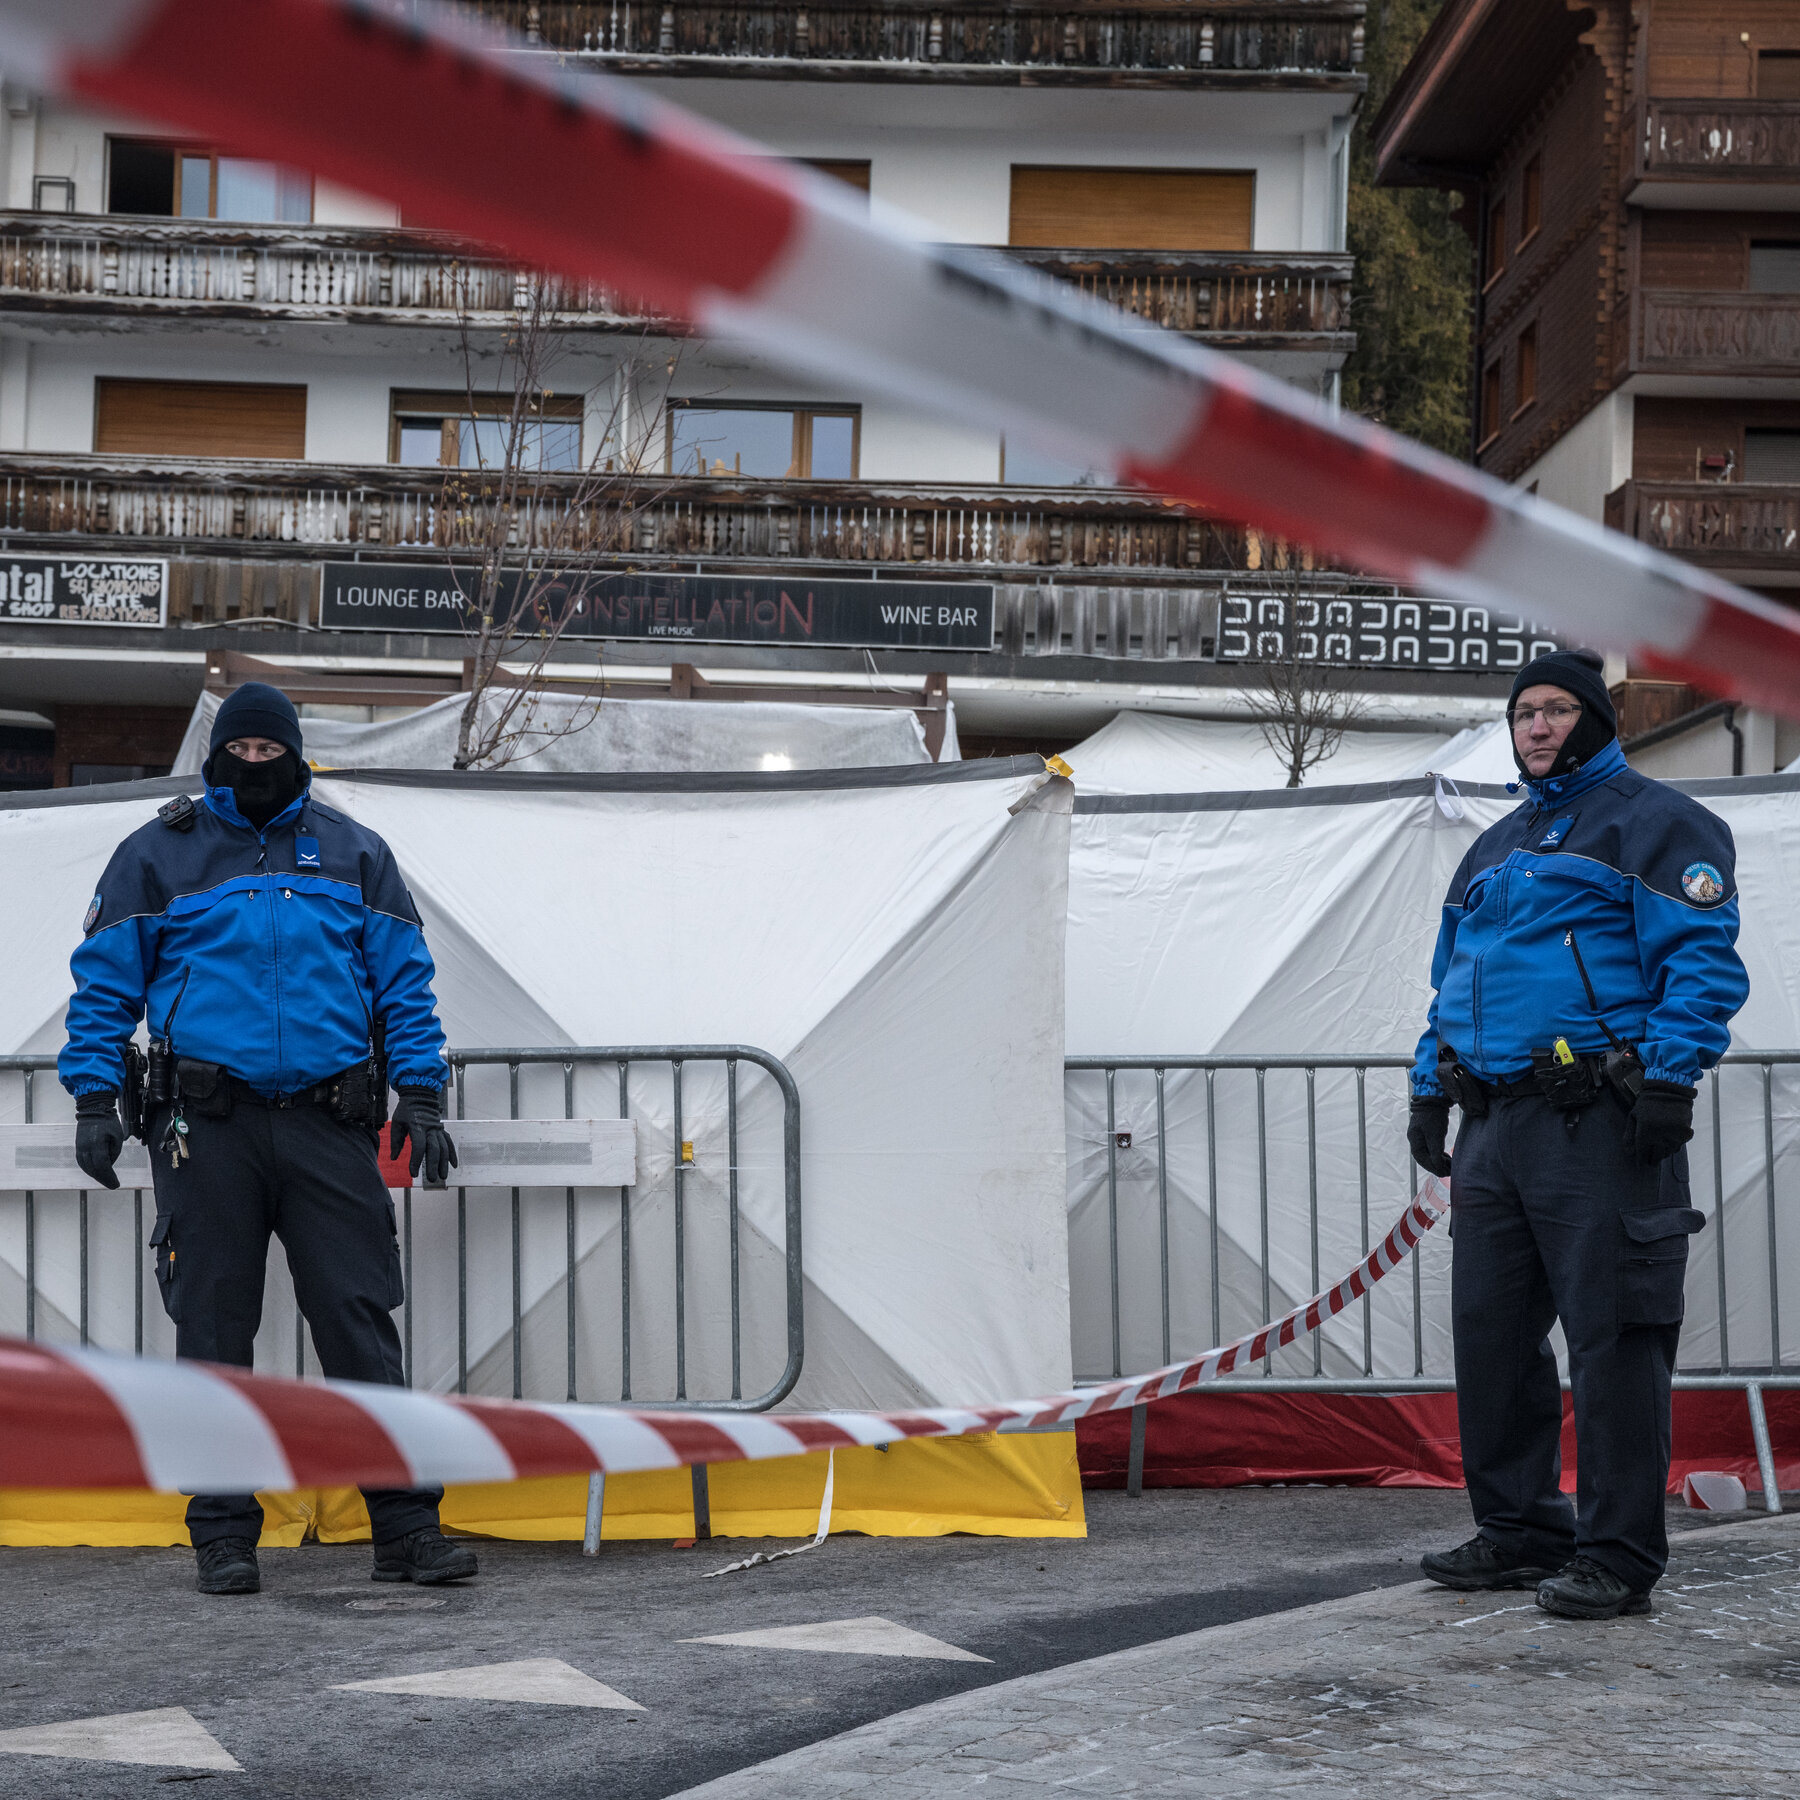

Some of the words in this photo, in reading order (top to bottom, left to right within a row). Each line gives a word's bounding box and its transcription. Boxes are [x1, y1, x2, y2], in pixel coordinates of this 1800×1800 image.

[61, 562, 160, 580] LOCATIONS
[81, 593, 144, 609] VENTE
[336, 587, 418, 608] LOUNGE
[424, 589, 464, 610] BAR
[9, 602, 55, 617] SHOP
[881, 605, 931, 626] WINE
[938, 606, 977, 627] BAR
[648, 626, 667, 635] LIVE
[668, 626, 696, 636] MUSIC
